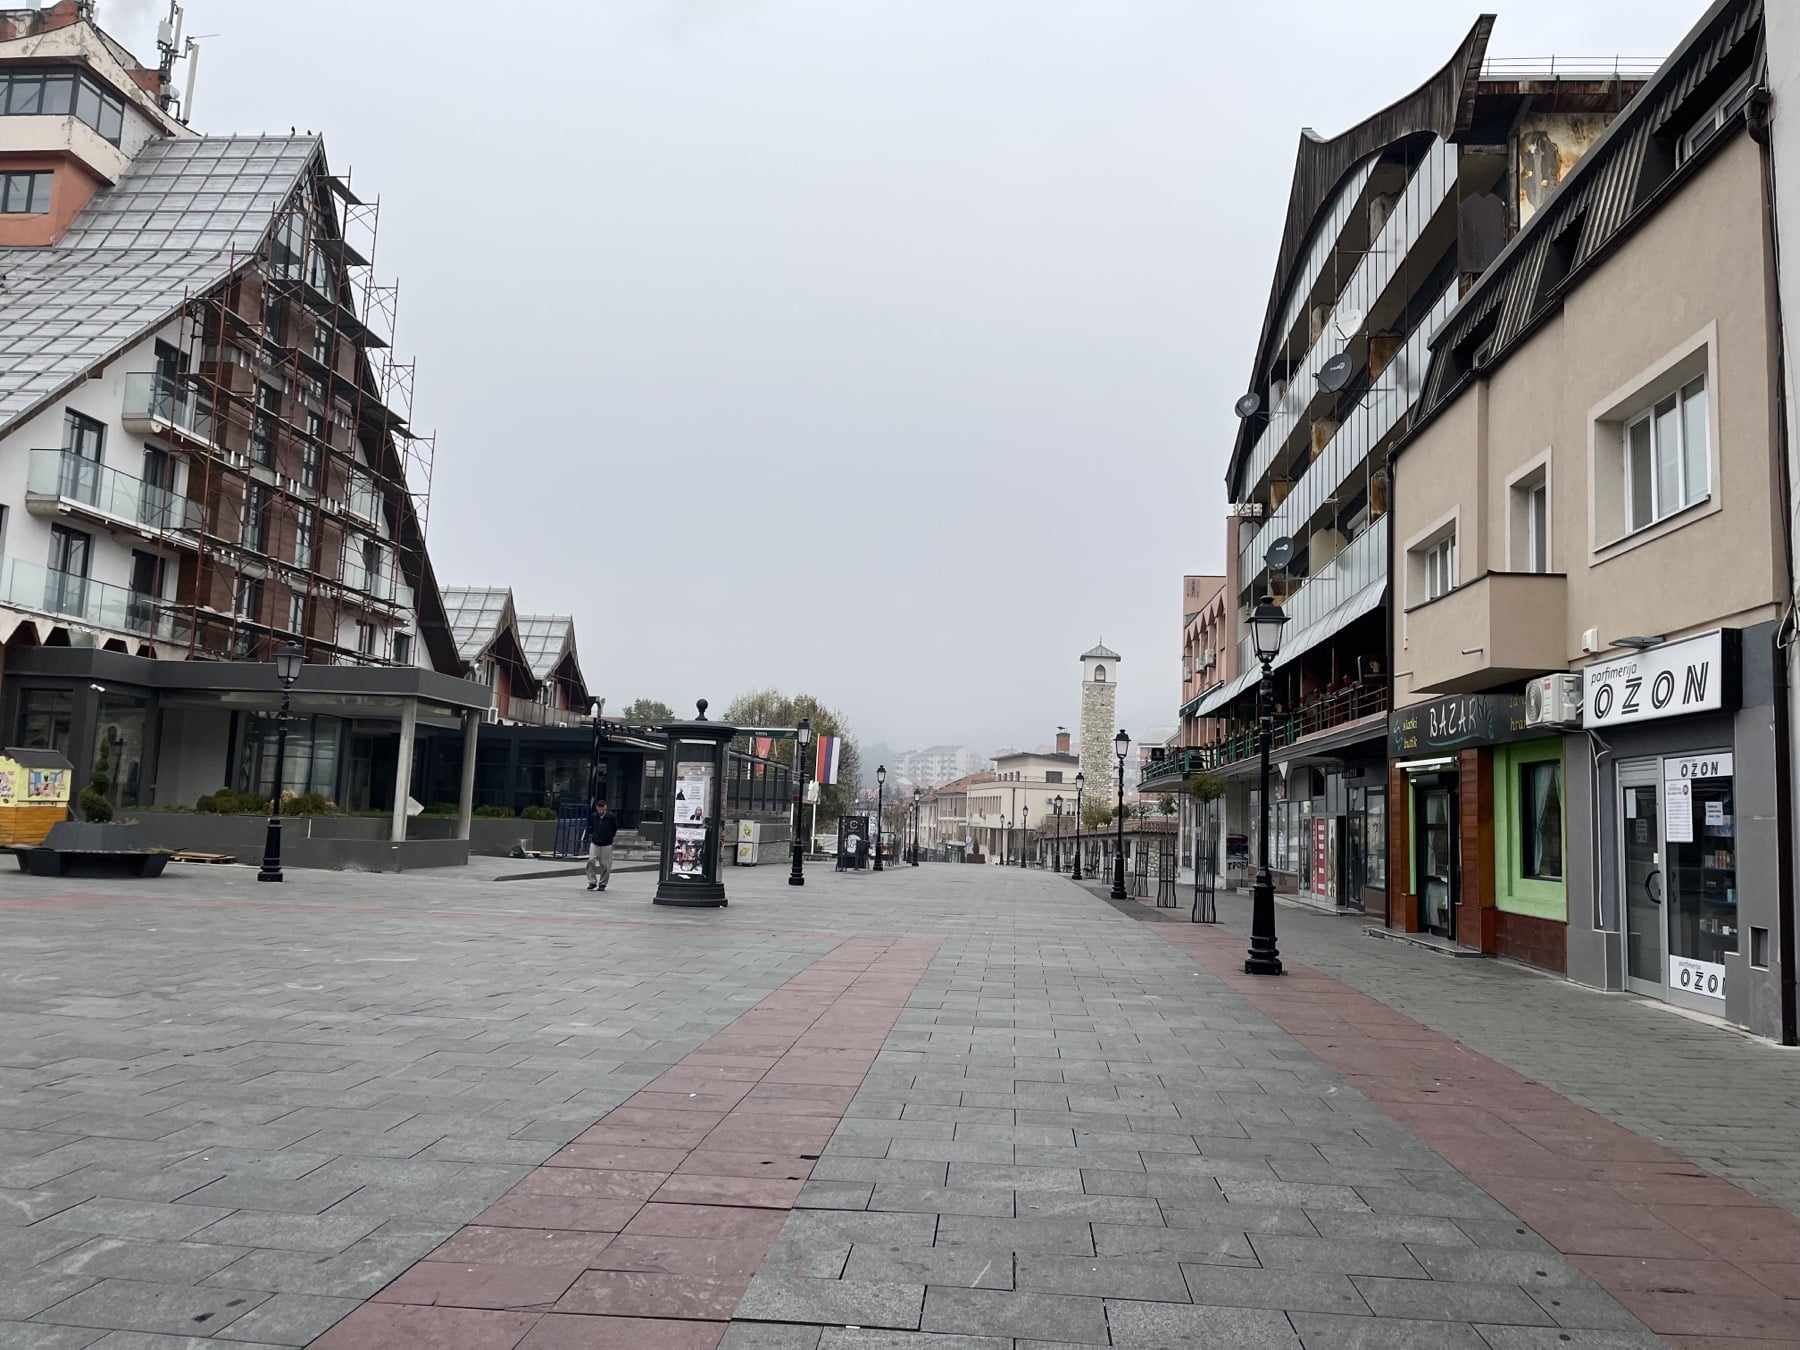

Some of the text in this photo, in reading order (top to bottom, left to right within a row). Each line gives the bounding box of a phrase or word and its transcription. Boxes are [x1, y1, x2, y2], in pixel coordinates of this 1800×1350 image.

[1591, 662, 1638, 687] parfimerija
[1594, 661, 1709, 719] OZON
[1680, 761, 1719, 778] OZON
[1680, 968, 1726, 996] OZO
